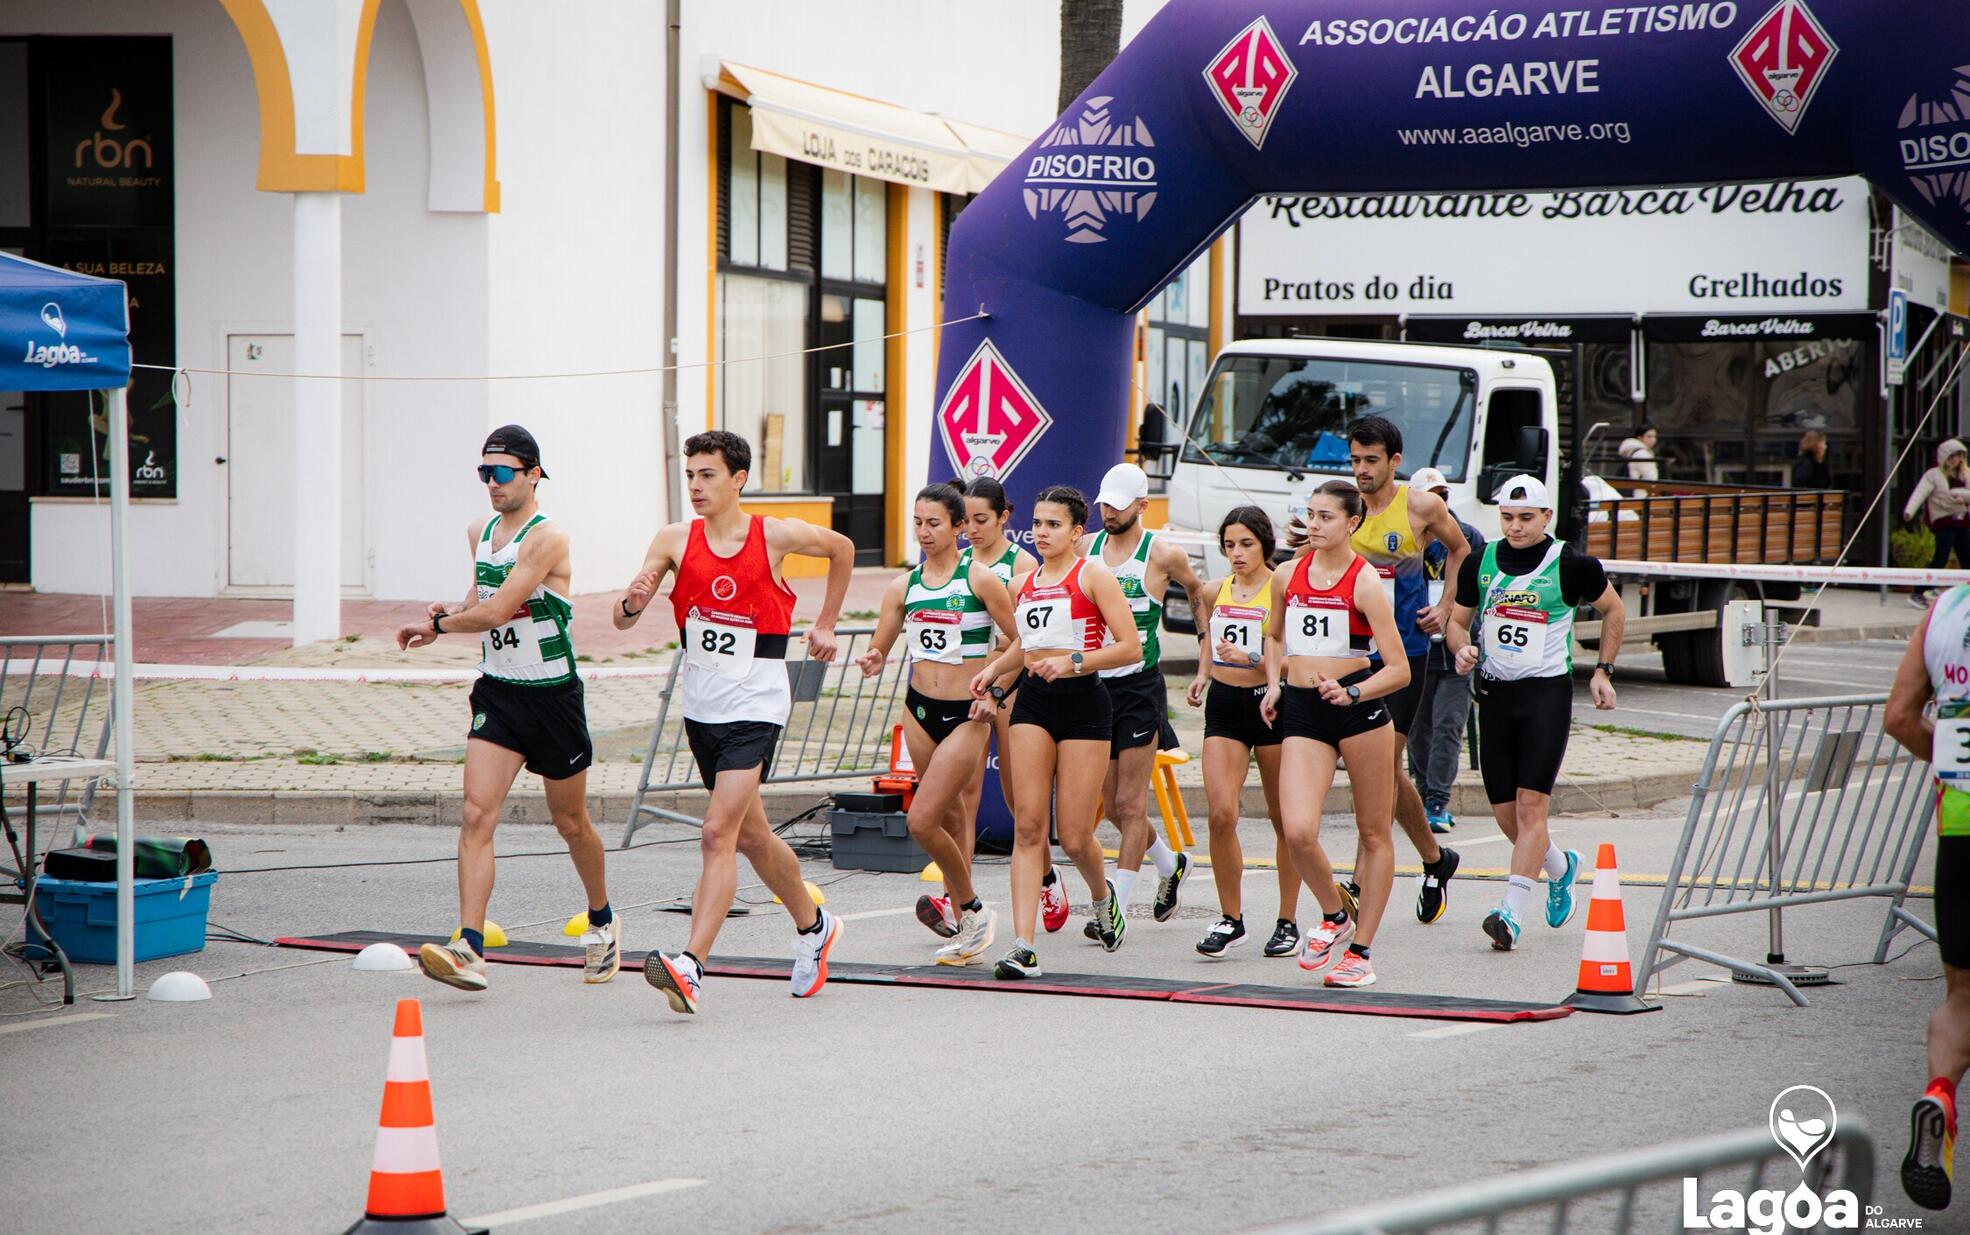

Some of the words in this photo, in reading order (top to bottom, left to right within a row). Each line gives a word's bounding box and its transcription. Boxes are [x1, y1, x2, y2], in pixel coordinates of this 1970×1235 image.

[1299, 10, 1526, 46] ASSOCIACÁO
[1532, 2, 1737, 40] ATLETISMO
[1414, 59, 1599, 99] ALGARVE
[802, 130, 838, 161] LOJA
[1398, 120, 1631, 148] www.aaalgarve.org
[75, 131, 153, 169] rbn
[1027, 154, 1156, 181] DISOFRIO
[67, 177, 117, 187] NATURAL
[118, 177, 162, 187] BEAUTY
[1265, 193, 1532, 228] Restaurante
[1542, 188, 1695, 219] Barca
[1697, 182, 1844, 214] Velha
[76, 262, 105, 274] SUA
[108, 262, 166, 275] BELEZA
[1263, 278, 1355, 301] Pratos
[1364, 275, 1399, 300] do
[1409, 275, 1455, 300] dia
[1688, 271, 1843, 299] Grelhados
[1463, 321, 1518, 339] Barca
[1517, 321, 1573, 338] Velha
[1701, 319, 1758, 337] Barca
[1758, 318, 1815, 335] Velha
[24, 340, 80, 369] Lagoa
[965, 435, 1001, 446] algarve
[136, 465, 164, 479] rbn
[1026, 605, 1054, 629] 67
[1302, 614, 1329, 637] 81
[489, 626, 521, 651] 84
[701, 629, 737, 656] 82
[920, 628, 947, 650] 63
[1223, 624, 1248, 646] 61
[1497, 624, 1529, 647] 65
